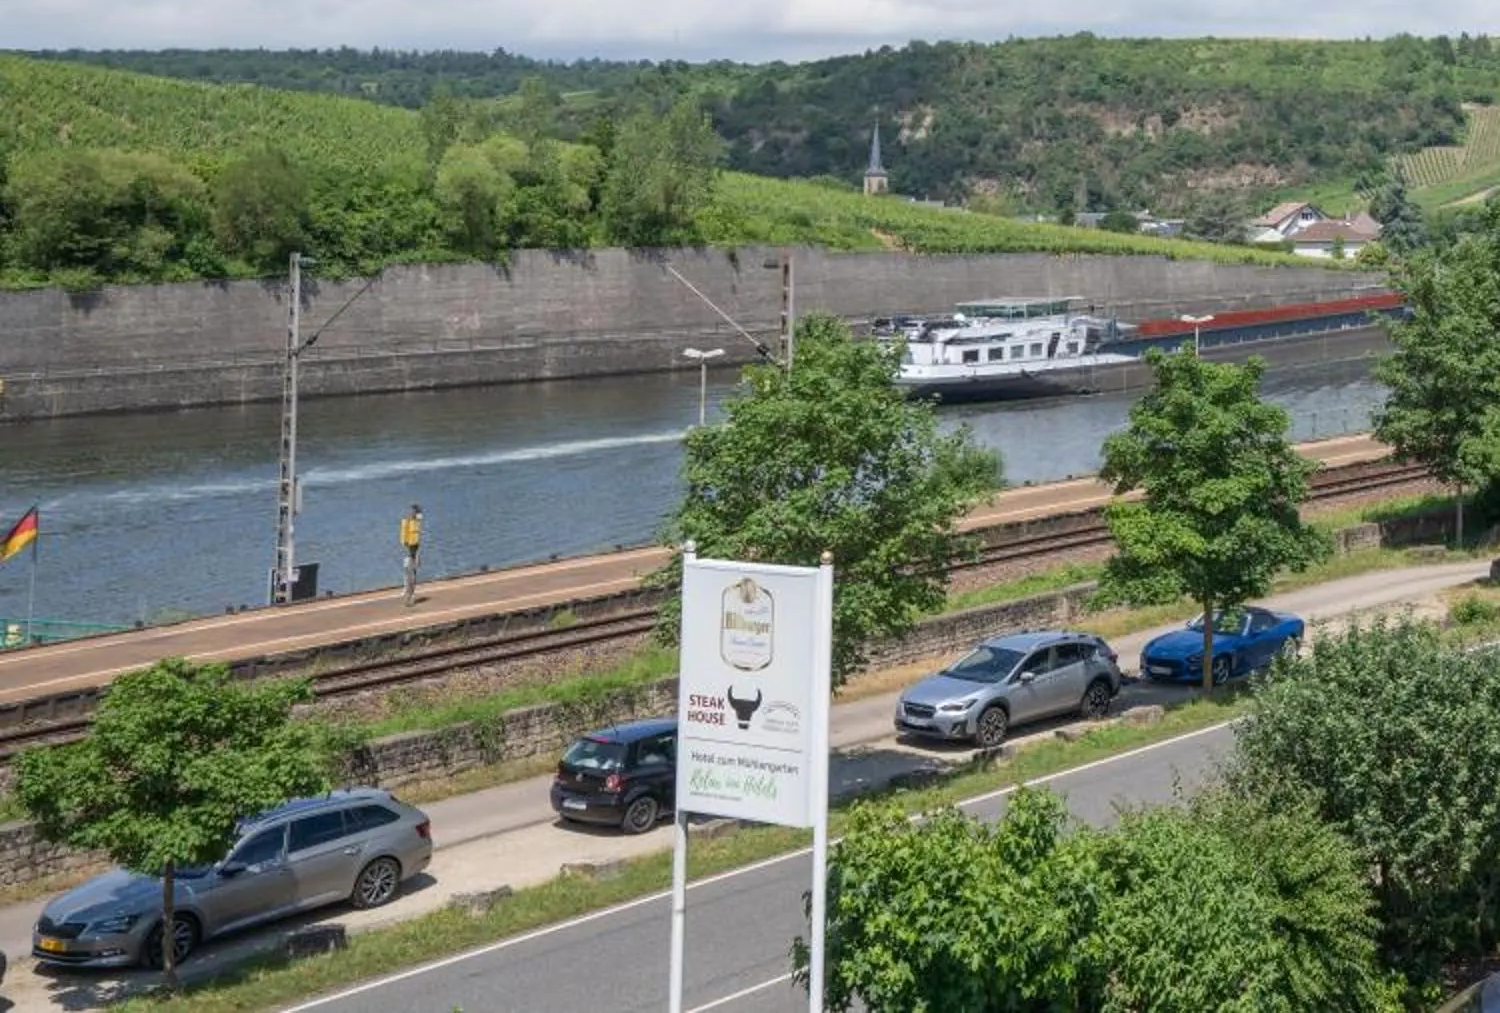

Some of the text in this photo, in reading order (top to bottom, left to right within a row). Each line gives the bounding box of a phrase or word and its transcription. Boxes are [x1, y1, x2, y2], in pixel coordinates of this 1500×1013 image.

[689, 694, 725, 710] STEAK
[688, 710, 727, 725] HOUSE
[691, 750, 714, 764] Hotel
